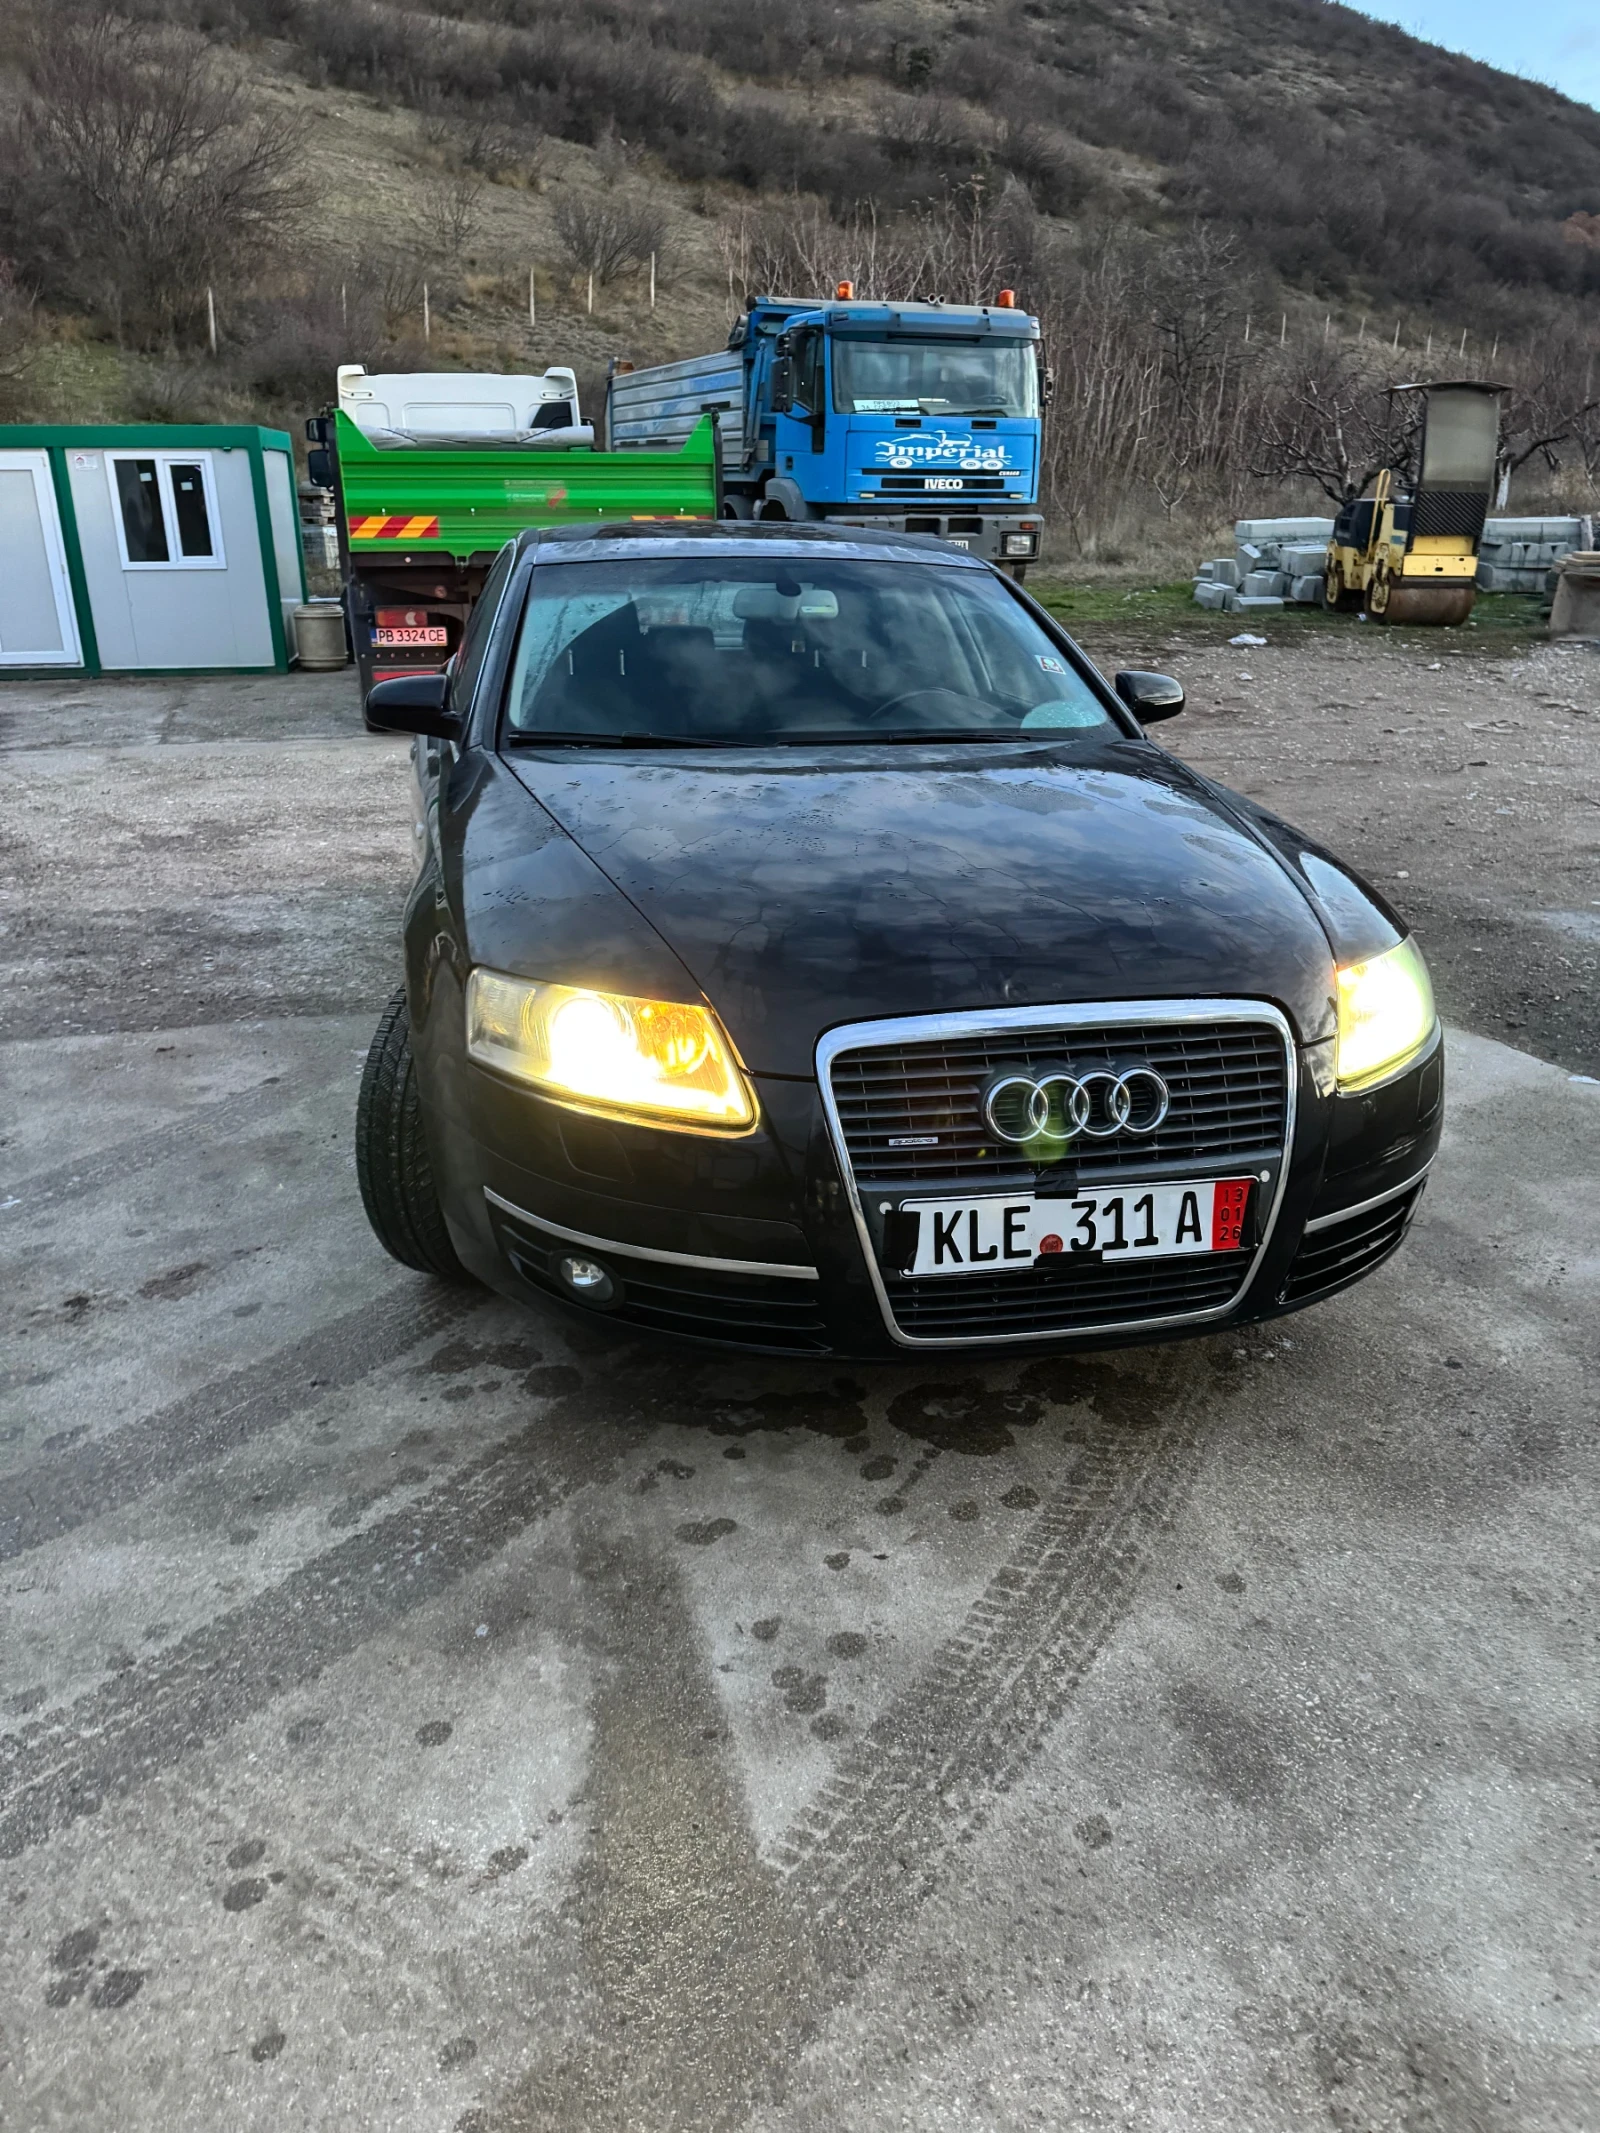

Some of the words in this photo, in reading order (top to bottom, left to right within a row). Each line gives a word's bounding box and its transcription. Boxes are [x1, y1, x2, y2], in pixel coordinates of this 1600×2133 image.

[875, 442, 1013, 460] Imperial
[924, 478, 963, 489] IVECO
[378, 629, 394, 642] PB
[396, 629, 426, 642] 3324
[428, 629, 445, 642] CE
[1224, 1187, 1244, 1203] 13
[1220, 1205, 1241, 1222] 01
[933, 1205, 1032, 1265] KLE
[1070, 1194, 1159, 1251] 311
[1175, 1190, 1203, 1244] A
[1219, 1225, 1241, 1241] 26
